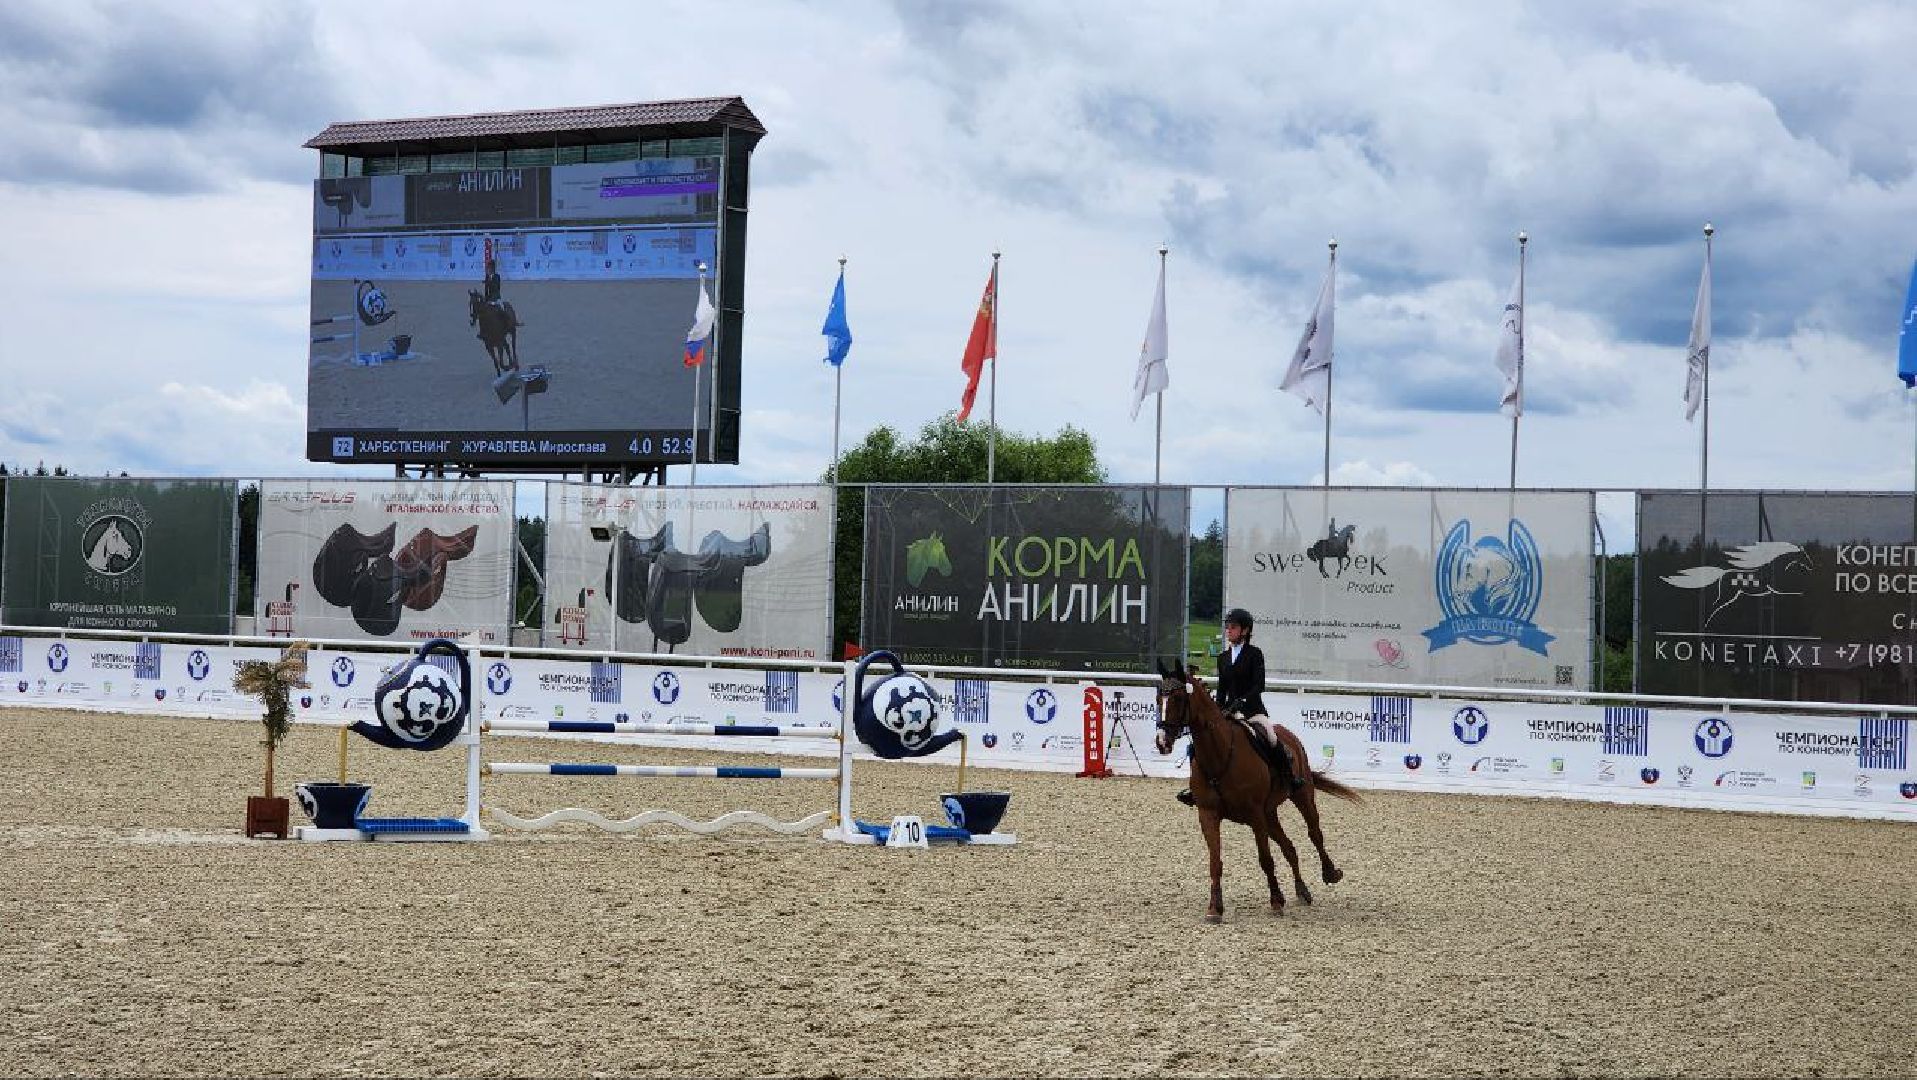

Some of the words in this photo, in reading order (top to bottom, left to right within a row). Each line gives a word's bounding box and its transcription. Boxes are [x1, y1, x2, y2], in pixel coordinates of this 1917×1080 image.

[462, 440, 537, 453] ЖУРАВЛЕВА
[540, 440, 606, 455] Мирослава
[629, 437, 652, 454] 4.0
[662, 437, 694, 454] 52.9
[988, 536, 1146, 579] КОРМА
[1836, 545, 1917, 567] КОНЕП
[1346, 580, 1395, 594] Product
[1835, 572, 1871, 592] ПО
[1878, 574, 1917, 594] ВСЕ
[105, 604, 125, 615] СЕТЬ
[126, 605, 177, 616] МАГАЗИНОВ
[894, 594, 959, 612] АНИЛИН
[977, 581, 1148, 624] АНИЛИН
[127, 618, 157, 628] СПОРТА
[720, 646, 815, 659] www.koni-poni.ru
[1655, 641, 1822, 666] KONETAXI
[1835, 643, 1861, 663] +7
[1868, 643, 1913, 668] (981
[708, 683, 771, 694] ЧЕМПИОНАТ
[1301, 709, 1379, 722] ЧЕМПИОНАТ
[1303, 720, 1317, 730] ПО
[1319, 721, 1365, 731] КОННОМУ
[1527, 719, 1612, 734] ЧЕМПИОНАТ
[1529, 731, 1545, 740] ПО
[1547, 732, 1597, 742] КОННОМУ
[1776, 732, 1868, 747] ЧЕМПИОНАТ
[1779, 744, 1795, 754] ПО
[1797, 745, 1852, 757] КОННОМУ
[905, 821, 920, 844] 10
